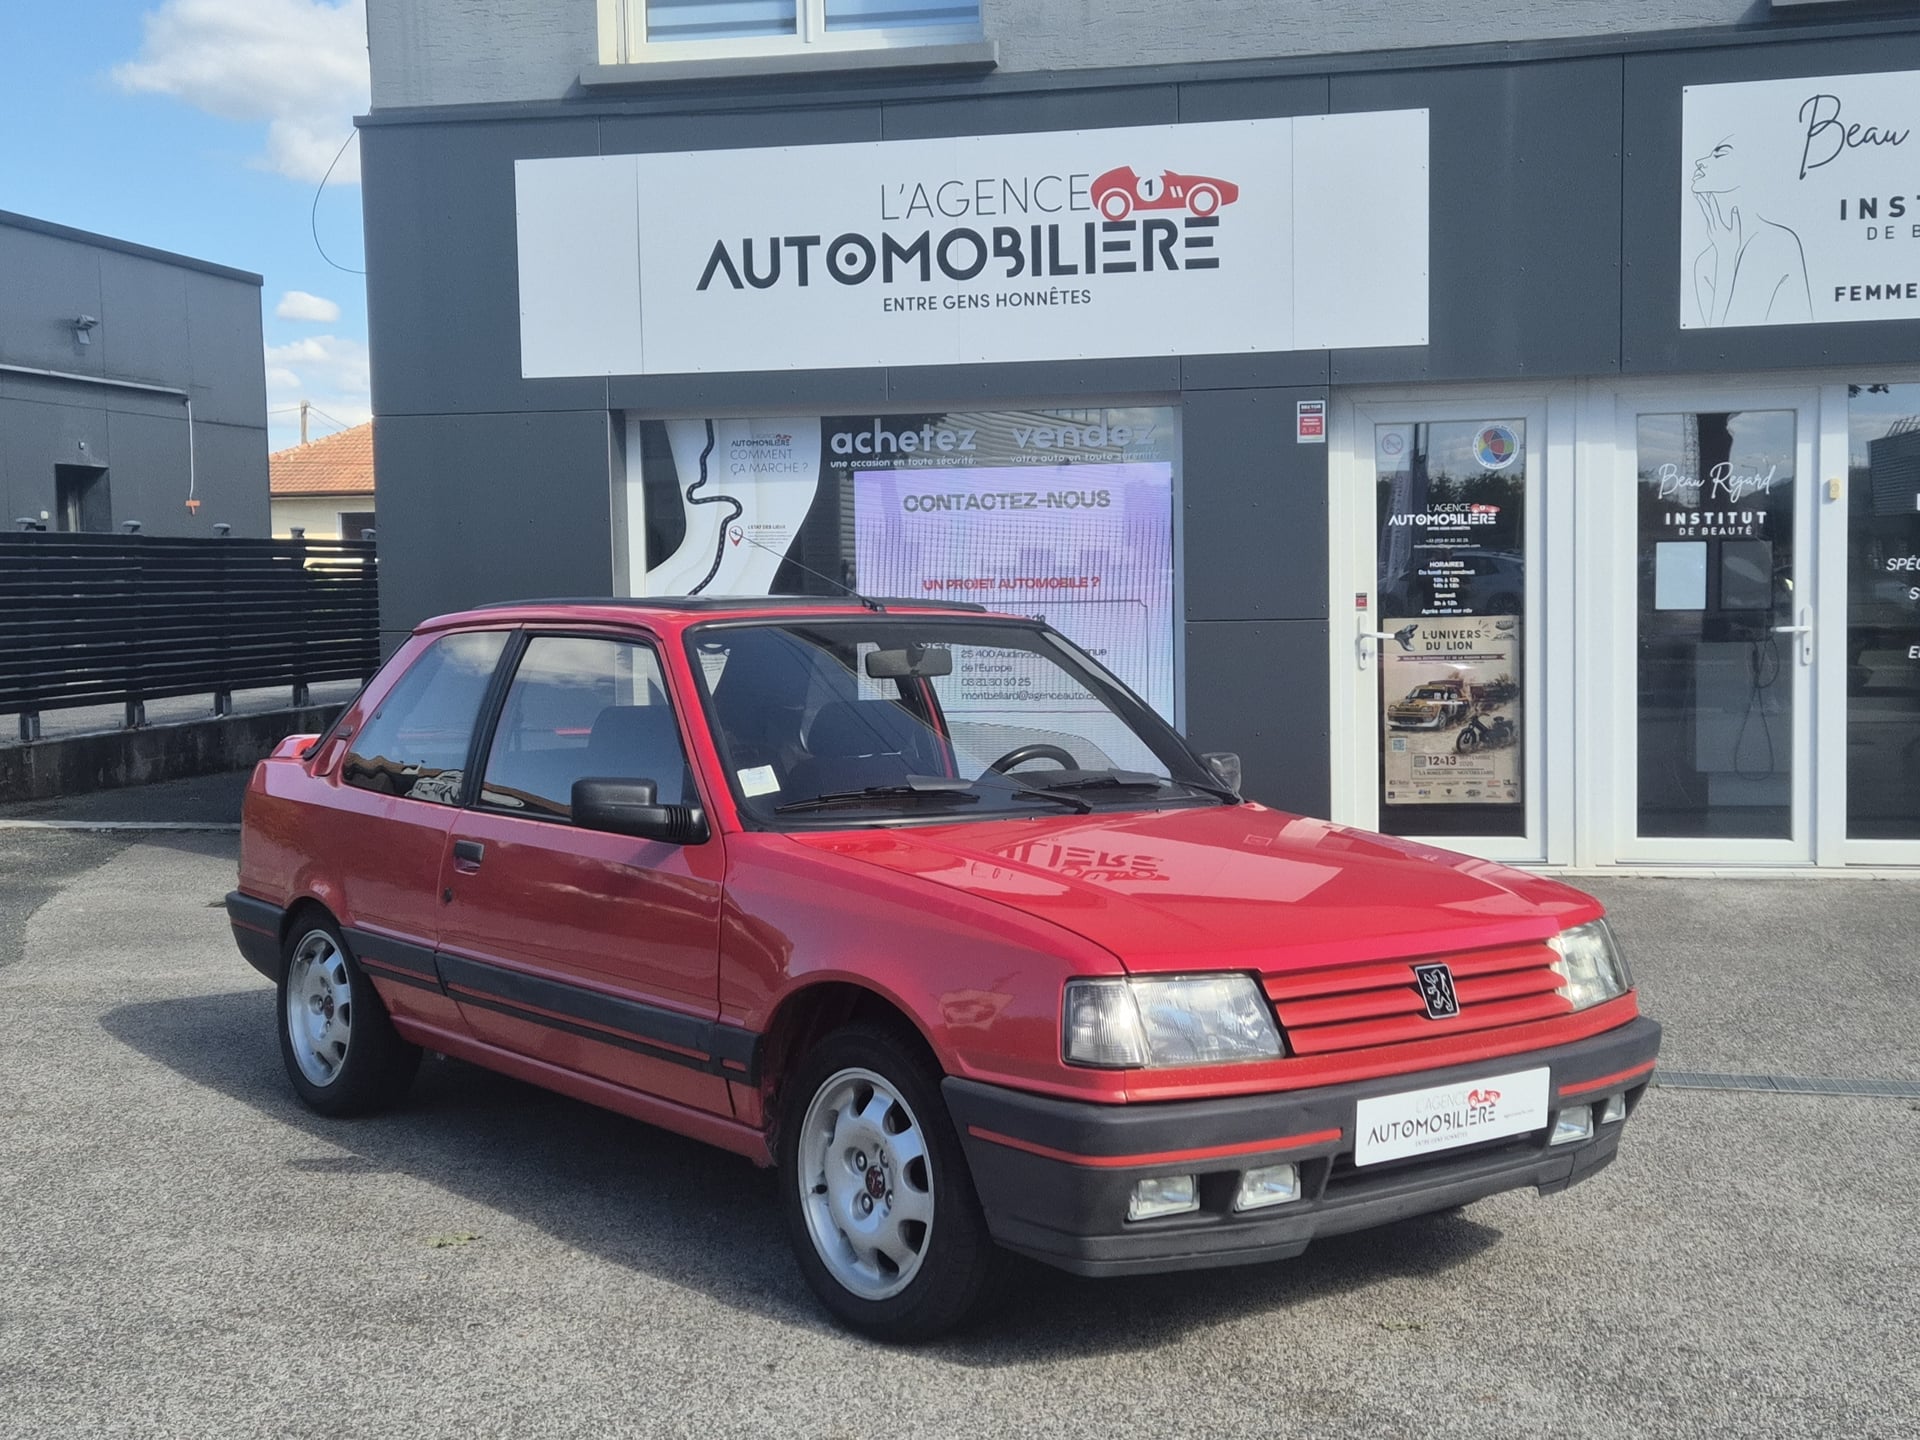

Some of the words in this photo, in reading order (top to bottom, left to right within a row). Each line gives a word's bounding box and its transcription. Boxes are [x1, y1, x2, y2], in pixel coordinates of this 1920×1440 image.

[1799, 94, 1910, 180] Beau
[881, 173, 1090, 220] L'AGENCE
[1866, 225, 1896, 241] DE
[882, 295, 938, 312] ENTRE
[942, 293, 990, 310] GENS
[995, 286, 1092, 308] HONNÊTES
[1011, 409, 1158, 449] vendez
[830, 418, 977, 455] achetez
[730, 449, 793, 461] COMMENT
[1010, 453, 1037, 463] votre
[1041, 453, 1065, 462] auto
[1068, 453, 1081, 462] en
[1085, 451, 1117, 462] toute
[730, 463, 746, 475] ÇA
[749, 462, 799, 473] MARCHE
[803, 462, 809, 473] ?
[830, 460, 848, 468] une
[850, 457, 891, 468] occasion
[908, 457, 934, 467] toute
[1658, 463, 1705, 499] Beau
[1709, 461, 1777, 503] Regard
[903, 489, 1111, 512] CONTACTEZ-NOUS
[1426, 503, 1471, 513] L'AGENCE
[1665, 511, 1768, 525] INSTITUT
[1678, 526, 1695, 536] DE
[1701, 525, 1753, 536] BEAUTÉ
[923, 579, 943, 591] UN
[946, 577, 994, 590] PROJET
[999, 576, 1089, 589] AUTOMOBILE
[1091, 576, 1100, 588] ?
[1426, 641, 1441, 651] DU
[1446, 641, 1473, 651] LION
[961, 663, 974, 673] de
[1018, 677, 1032, 687] 25
